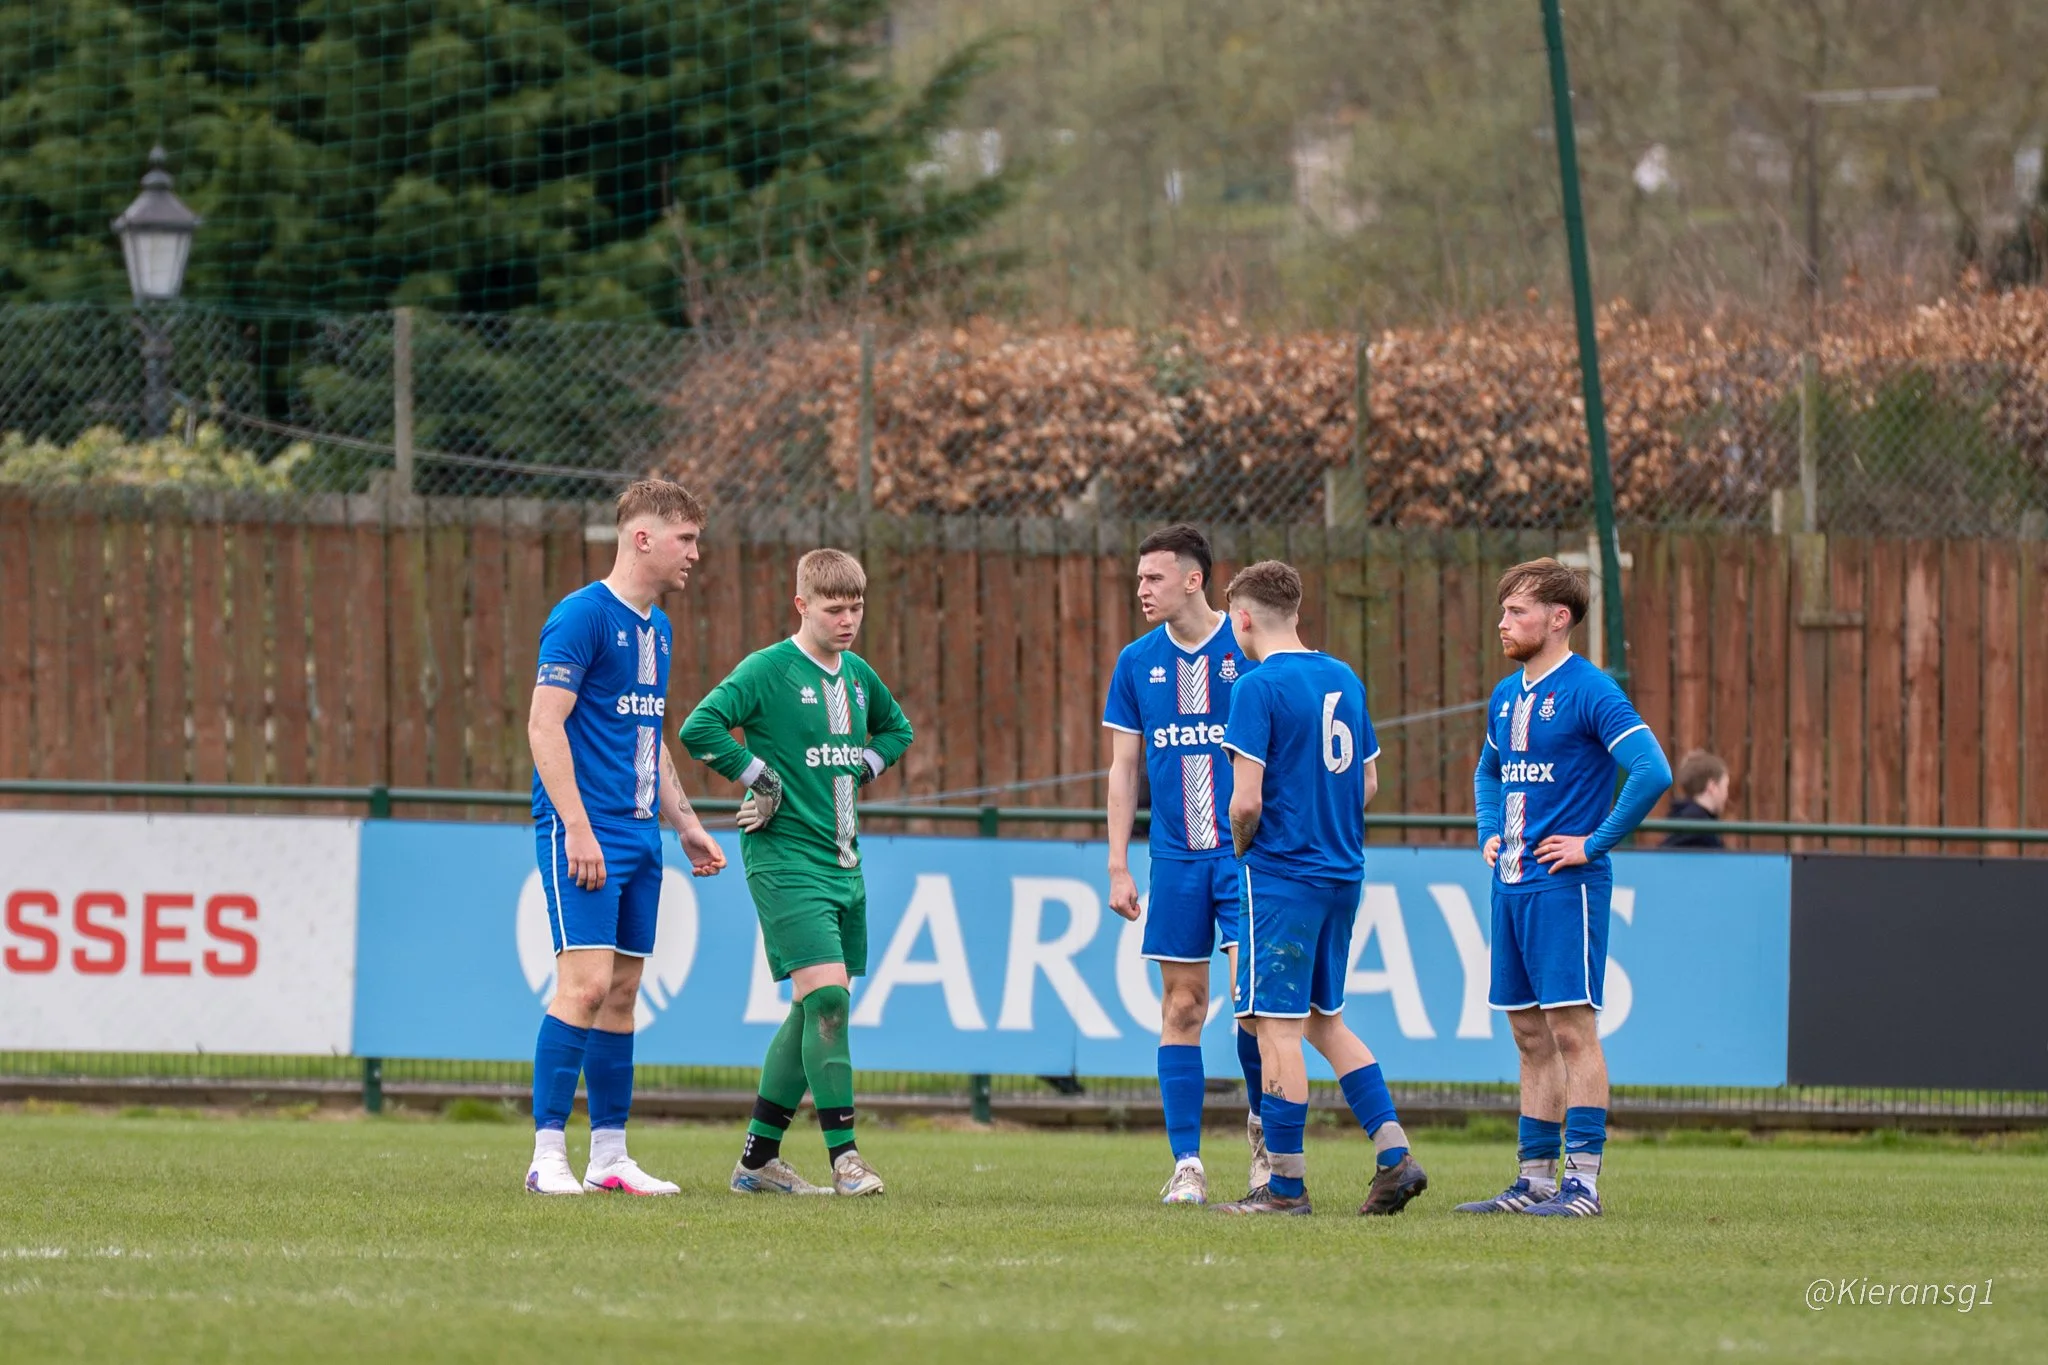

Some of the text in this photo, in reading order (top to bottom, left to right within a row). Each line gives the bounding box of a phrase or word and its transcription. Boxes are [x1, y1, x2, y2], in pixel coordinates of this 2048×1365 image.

[805, 743, 864, 767] state
[1153, 721, 1228, 748] state
[1322, 691, 1354, 774] 6
[3, 889, 260, 978] SSES
